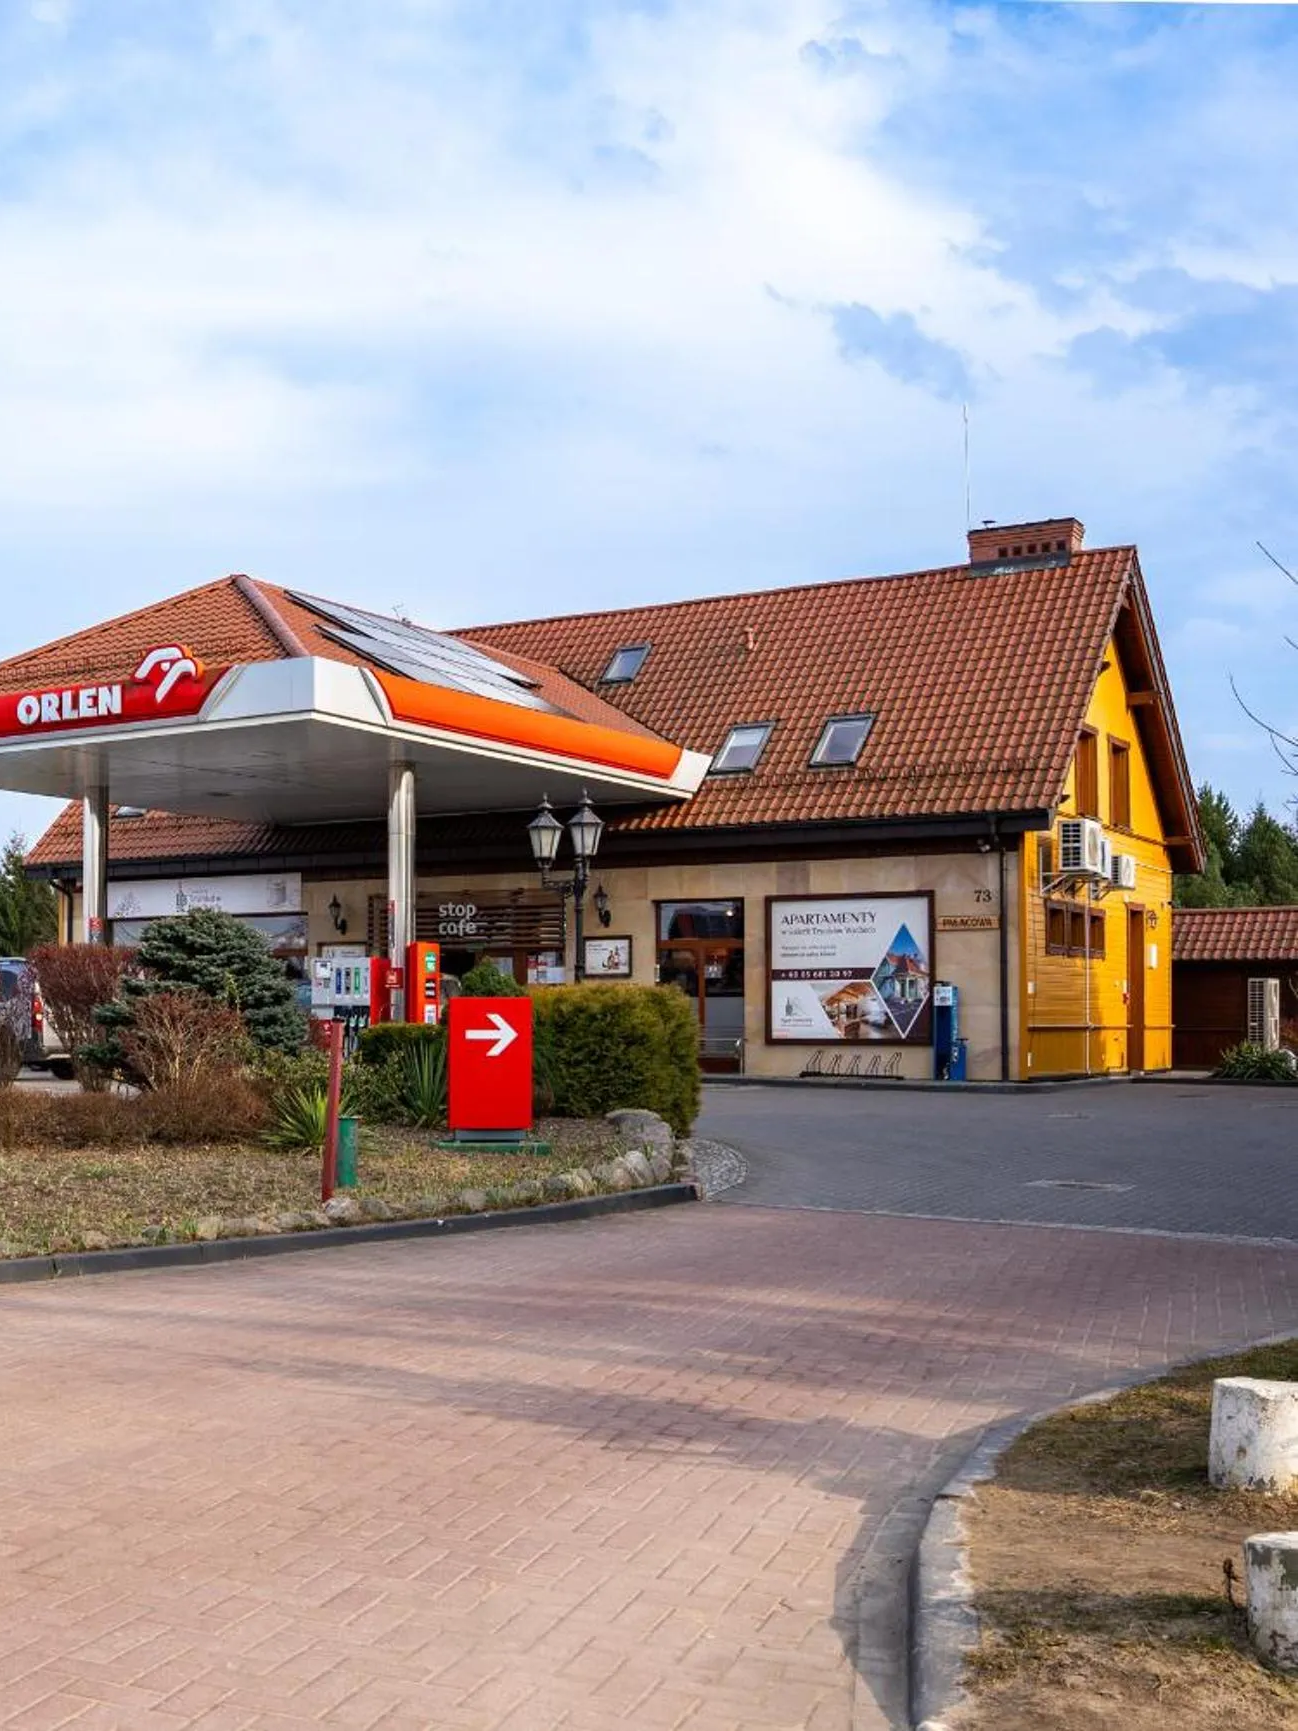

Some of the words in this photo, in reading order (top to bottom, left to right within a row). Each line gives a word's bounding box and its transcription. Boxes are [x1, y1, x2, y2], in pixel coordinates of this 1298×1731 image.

[17, 684, 122, 726] ORLEN
[974, 889, 992, 903] 73
[438, 902, 477, 919] stop
[781, 911, 877, 926] APARTAMENTY
[438, 919, 477, 937] cafe
